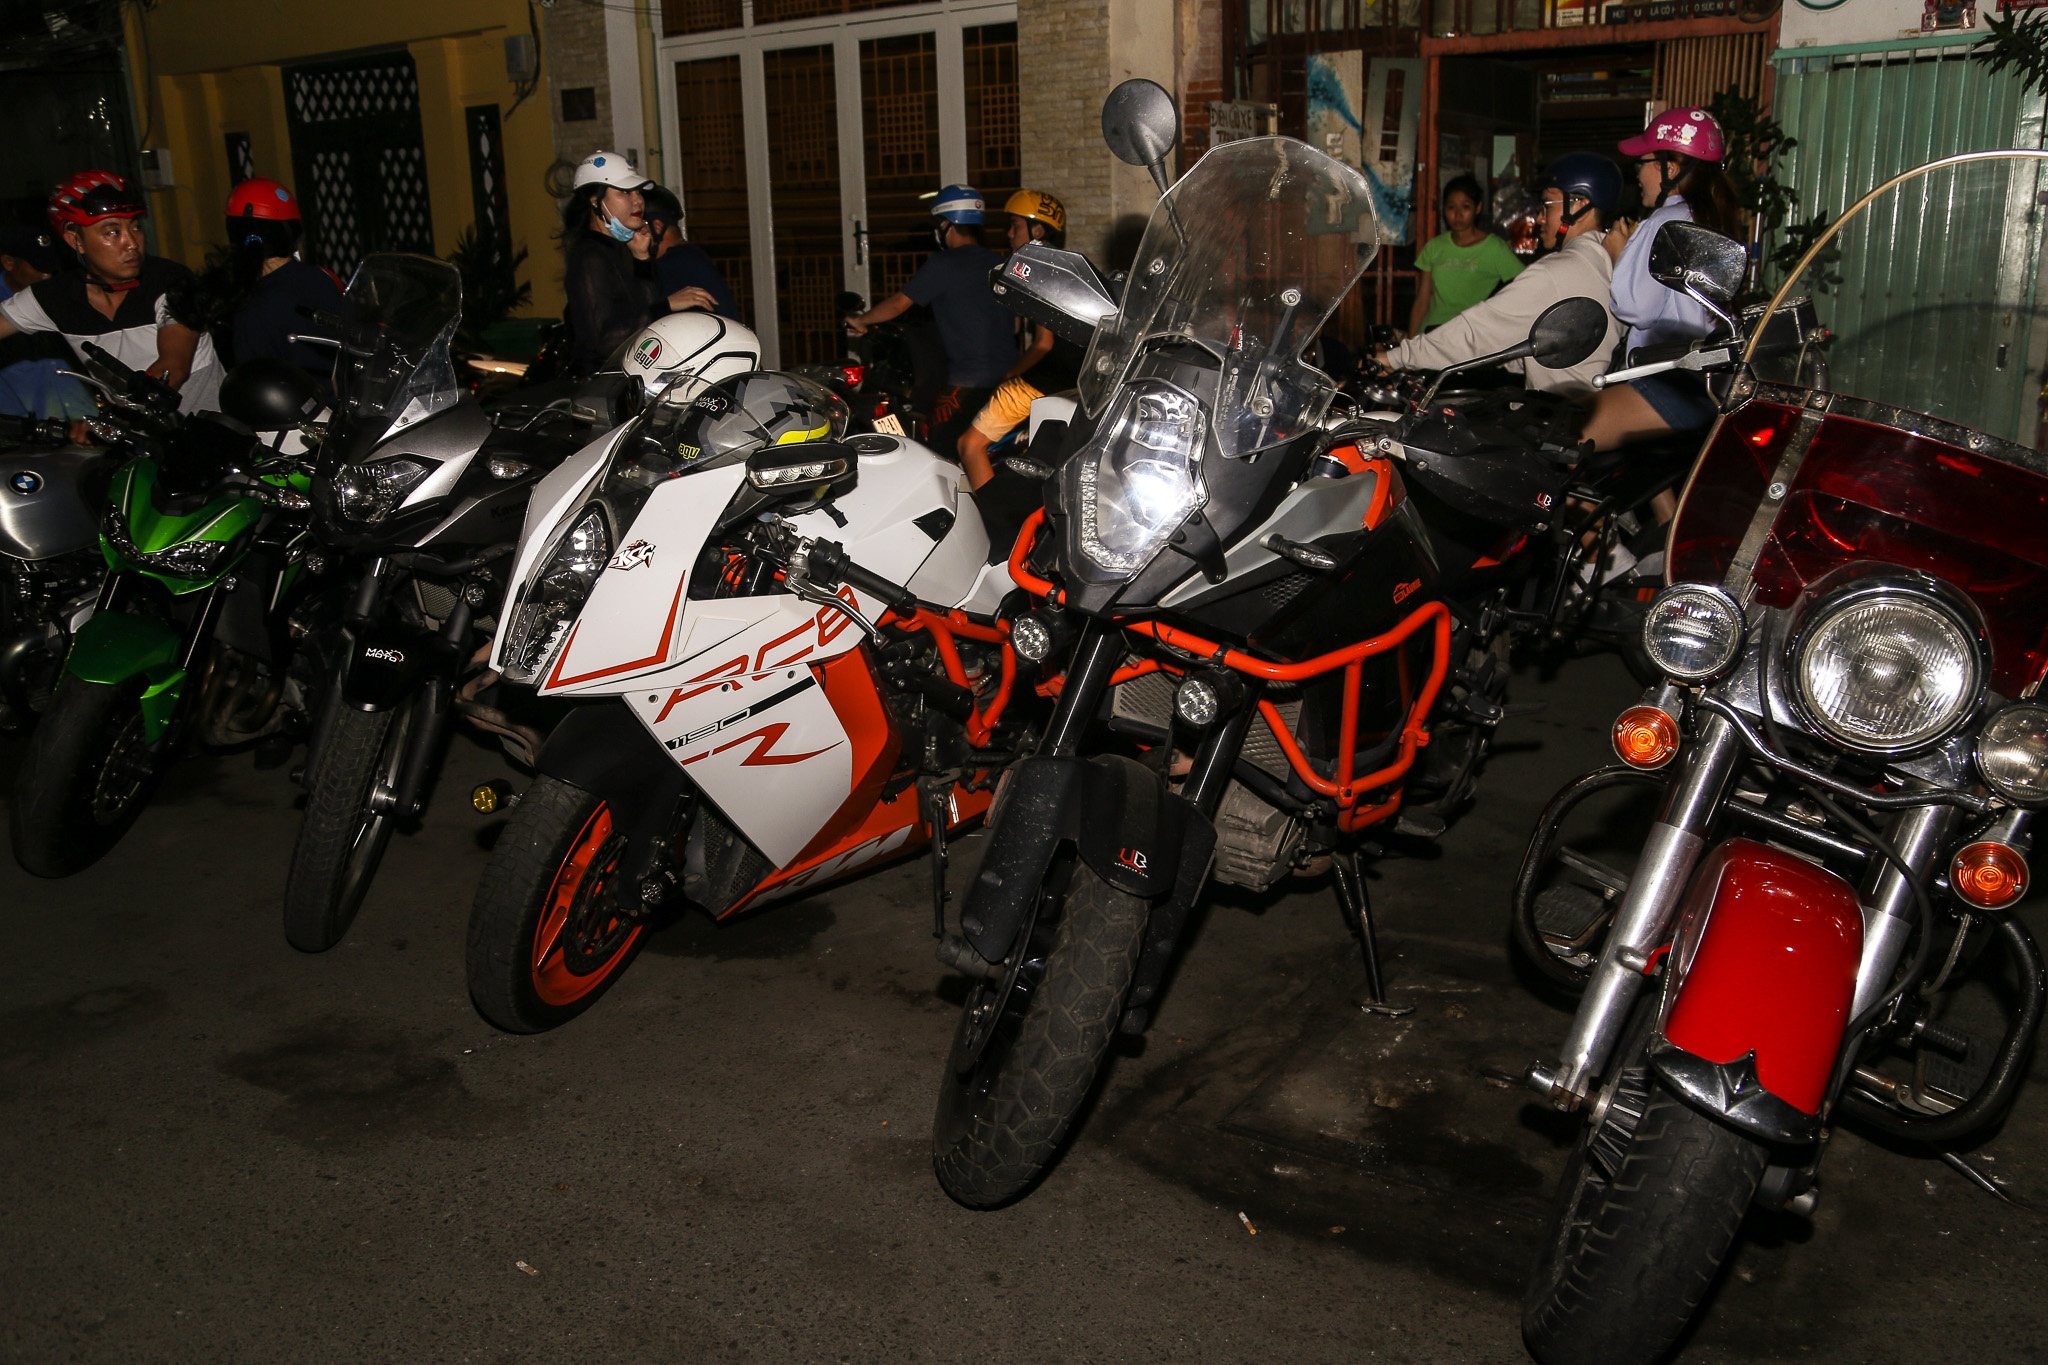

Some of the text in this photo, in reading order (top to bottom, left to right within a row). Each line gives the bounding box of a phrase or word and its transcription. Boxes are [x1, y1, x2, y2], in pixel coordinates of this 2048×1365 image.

[695, 401, 719, 412] MOTO
[678, 443, 701, 460] agv
[365, 652, 397, 663] MOTO
